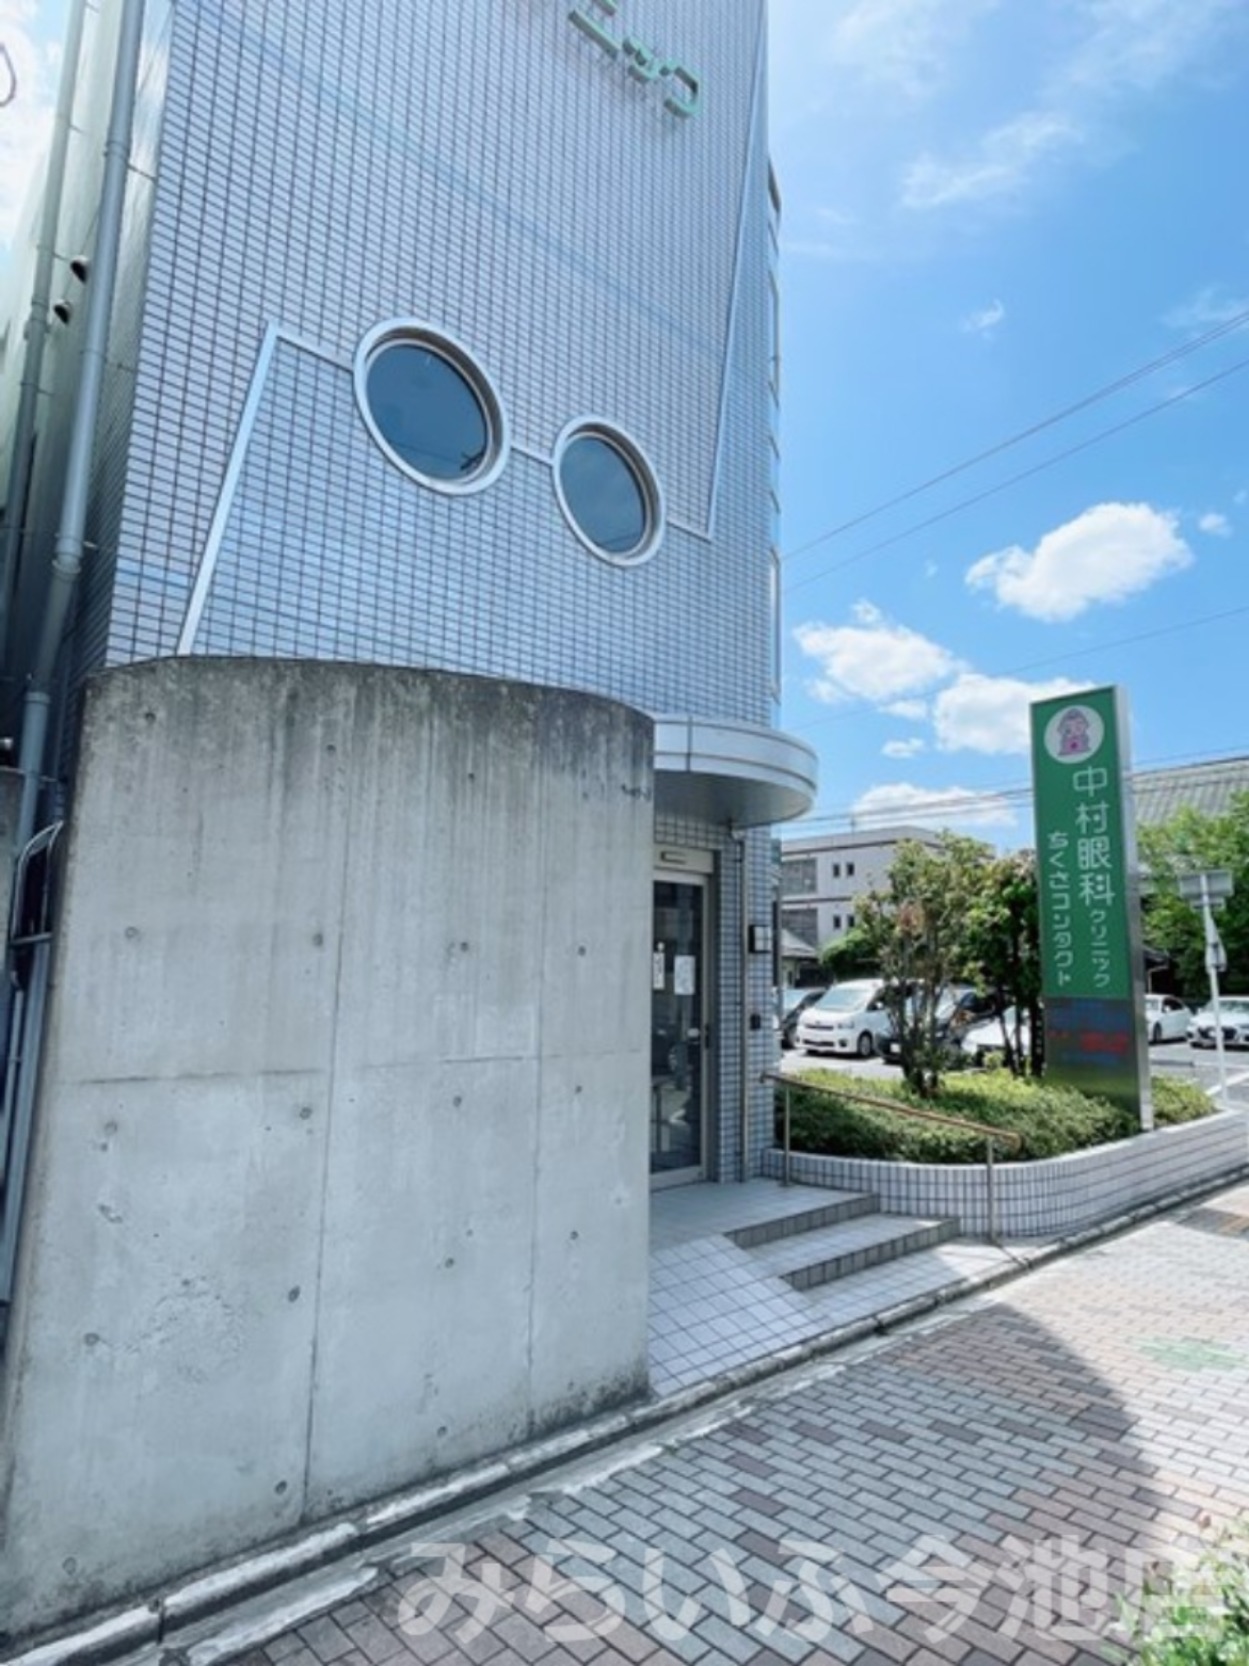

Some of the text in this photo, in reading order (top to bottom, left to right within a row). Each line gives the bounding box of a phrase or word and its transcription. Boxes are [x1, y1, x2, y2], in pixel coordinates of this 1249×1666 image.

[1048, 830, 1073, 987] ちくさコンタクト
[1073, 765, 1116, 987] 中村眼科クリニック
